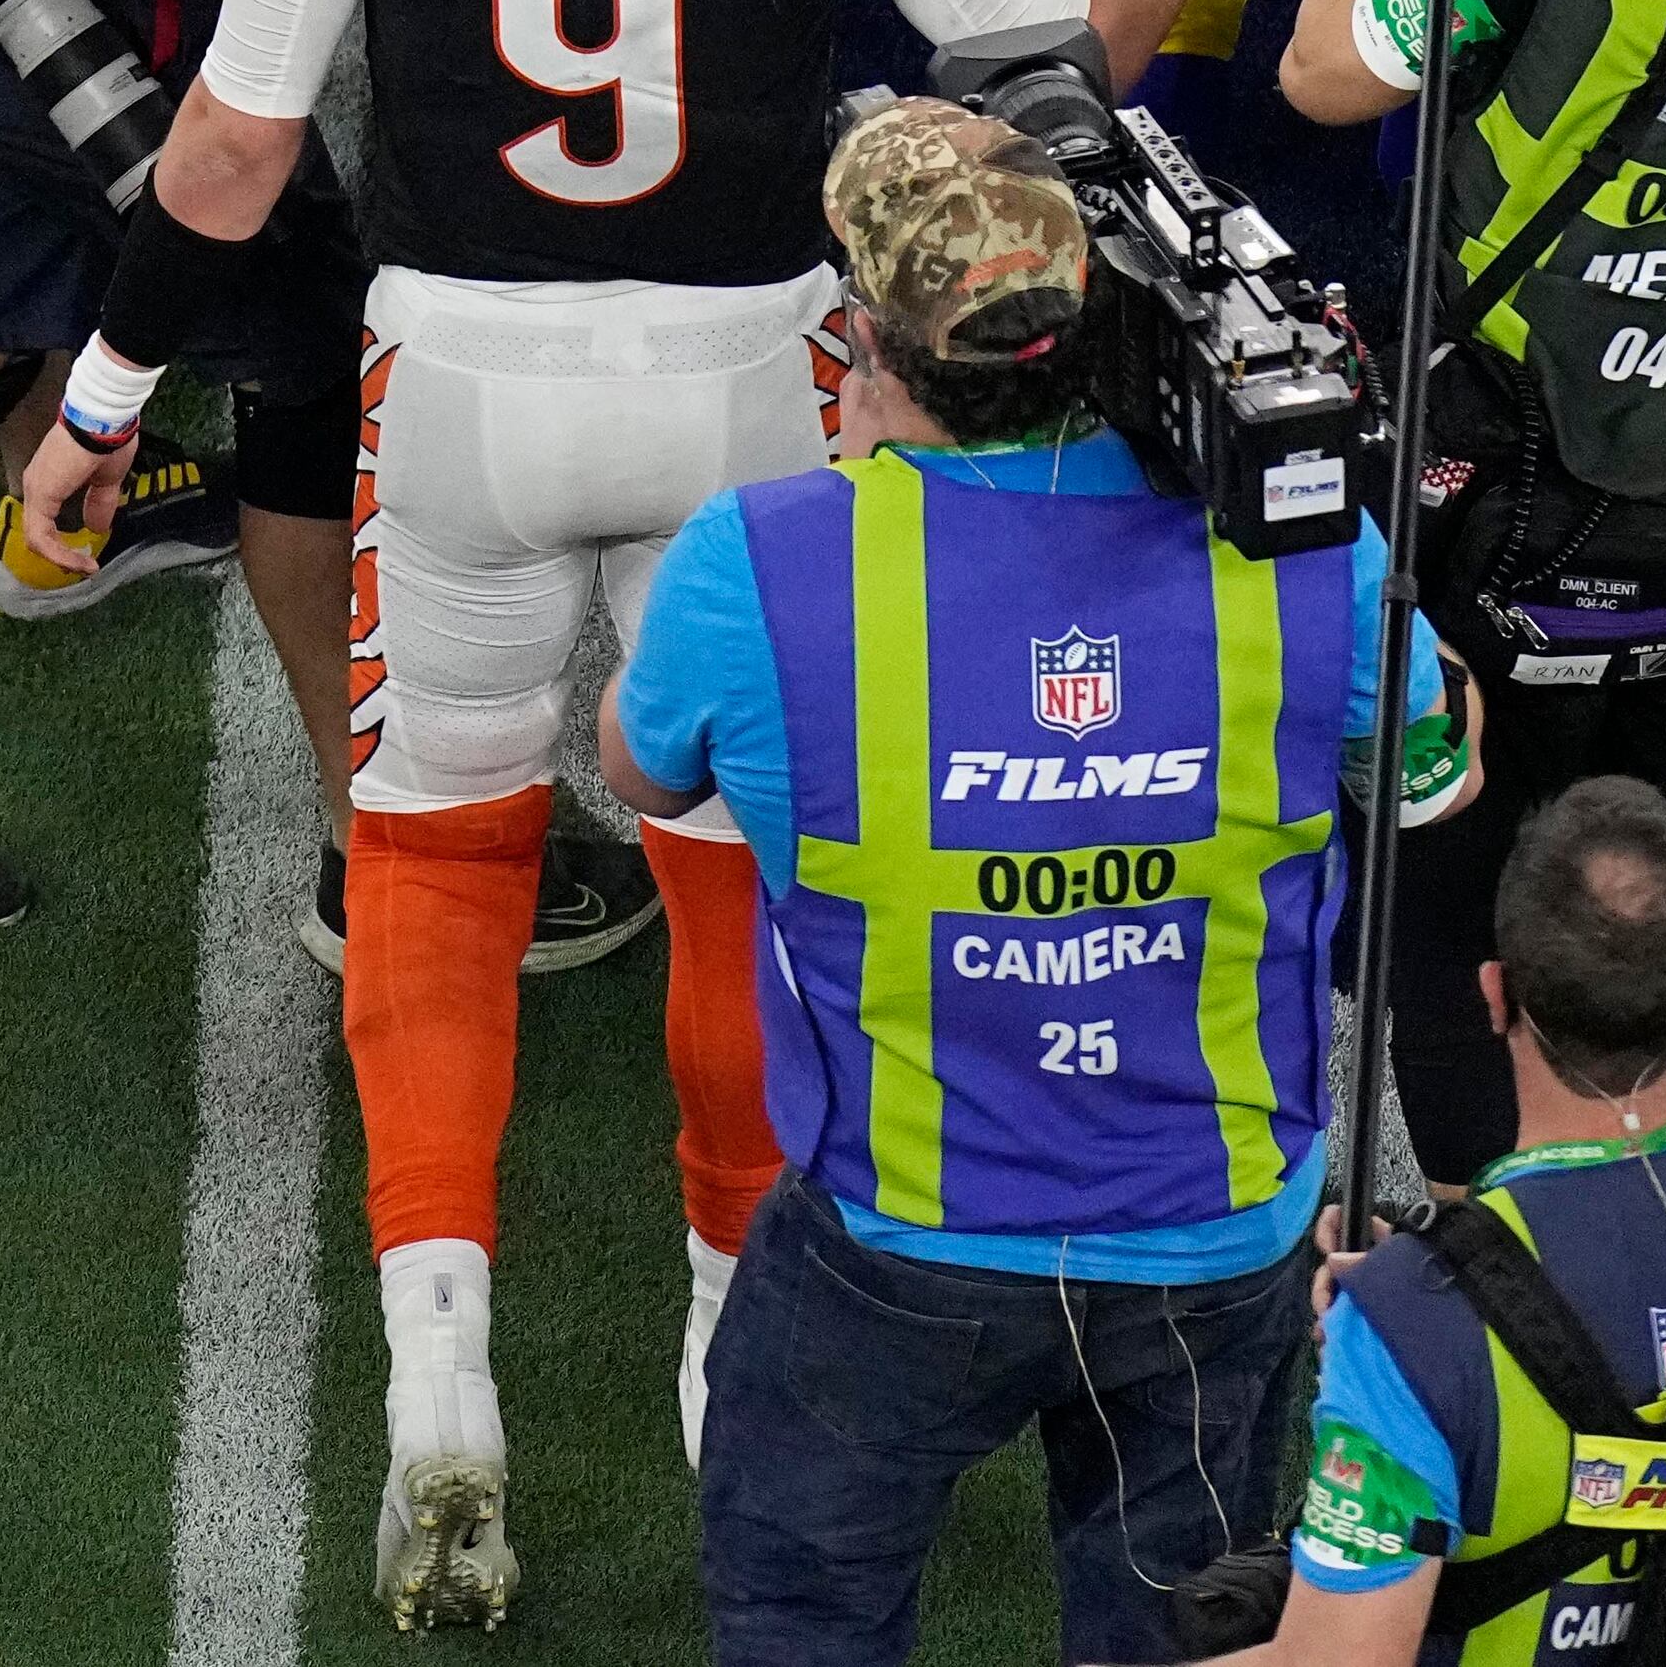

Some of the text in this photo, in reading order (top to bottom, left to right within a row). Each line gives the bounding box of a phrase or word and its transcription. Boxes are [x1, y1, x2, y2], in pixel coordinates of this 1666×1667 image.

[1559, 577, 1638, 596] DMN_CLIENT
[1533, 664, 1597, 681] RYAN
[1044, 676, 1111, 724] NFL
[939, 746, 1211, 803] FILMS
[976, 847, 1178, 916] 00:00
[952, 922, 1186, 986] CAMERA
[1038, 1019, 1120, 1076] 25
[1574, 1477, 1614, 1502] NFL
